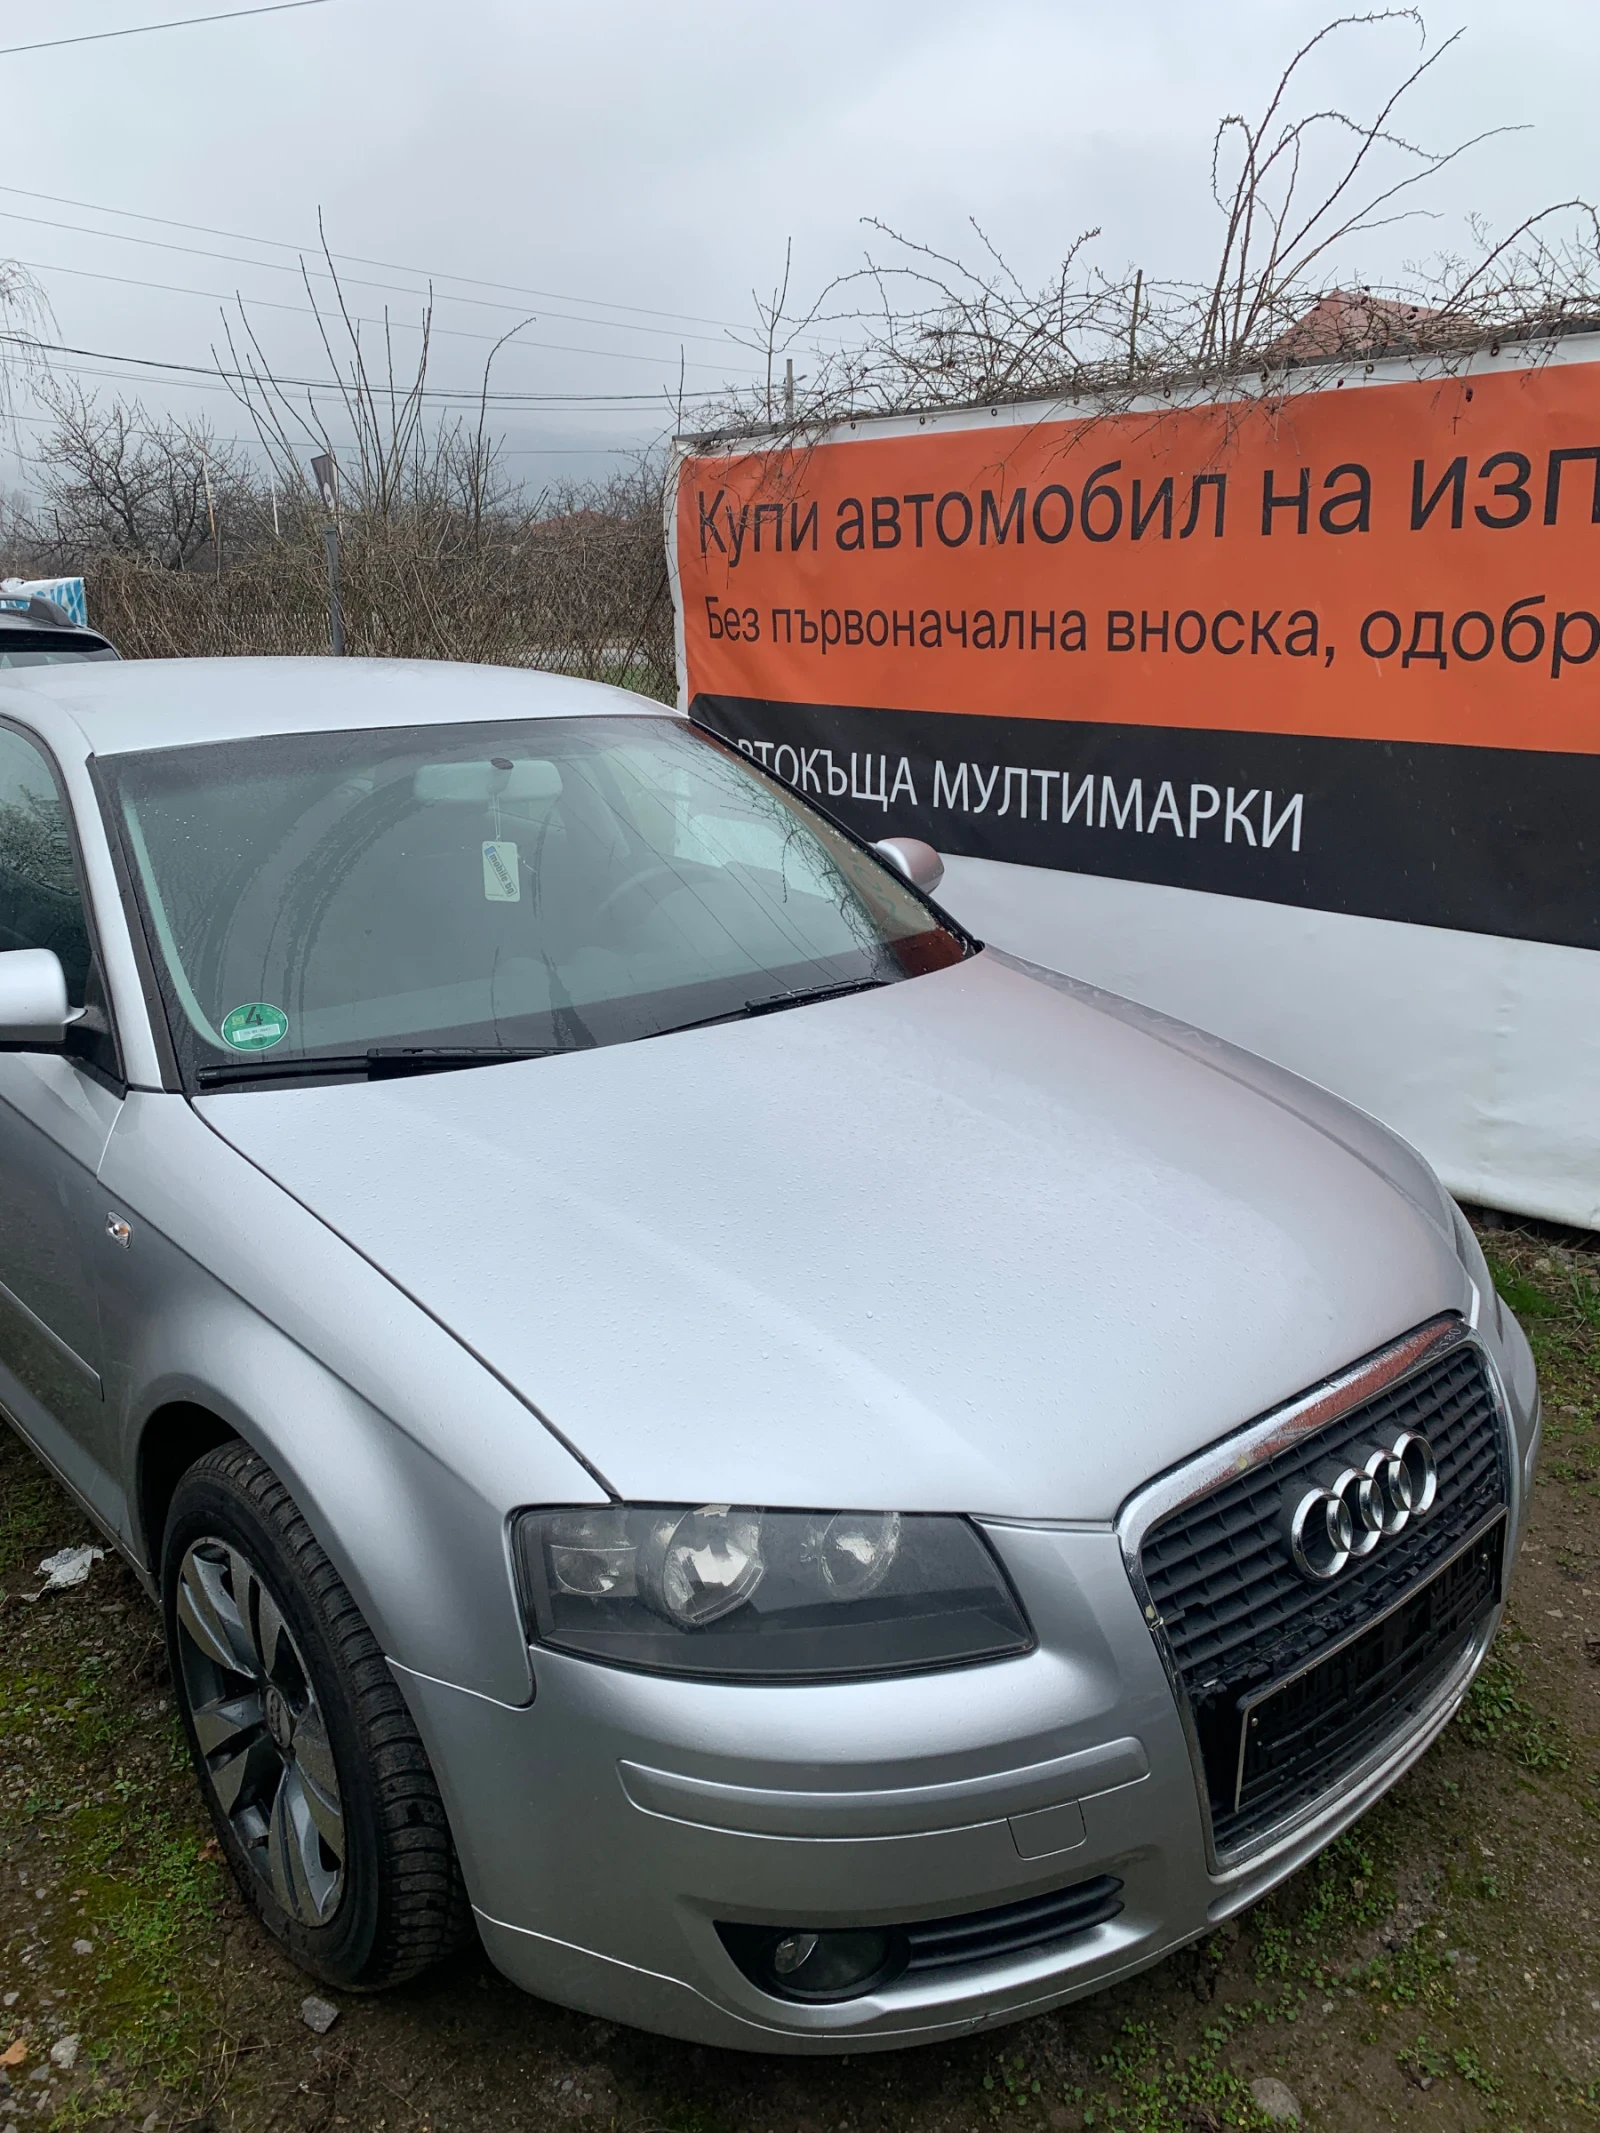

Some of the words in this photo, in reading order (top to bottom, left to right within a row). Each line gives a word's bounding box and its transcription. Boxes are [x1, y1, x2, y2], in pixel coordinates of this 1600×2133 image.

[697, 489, 818, 568] Купи
[835, 460, 1227, 551] автомобил
[1261, 463, 1371, 536] на
[1410, 446, 1600, 531] изп
[704, 595, 760, 643] Без
[771, 608, 1087, 655] първоначална
[1107, 610, 1336, 668] вноска,
[1360, 594, 1600, 679] одобр
[737, 738, 918, 813] ТОКЪЩА
[933, 760, 1304, 852] МУЛТИМАРКИ
[488, 853, 515, 896] mobile.bg
[245, 1006, 264, 1026] 4
